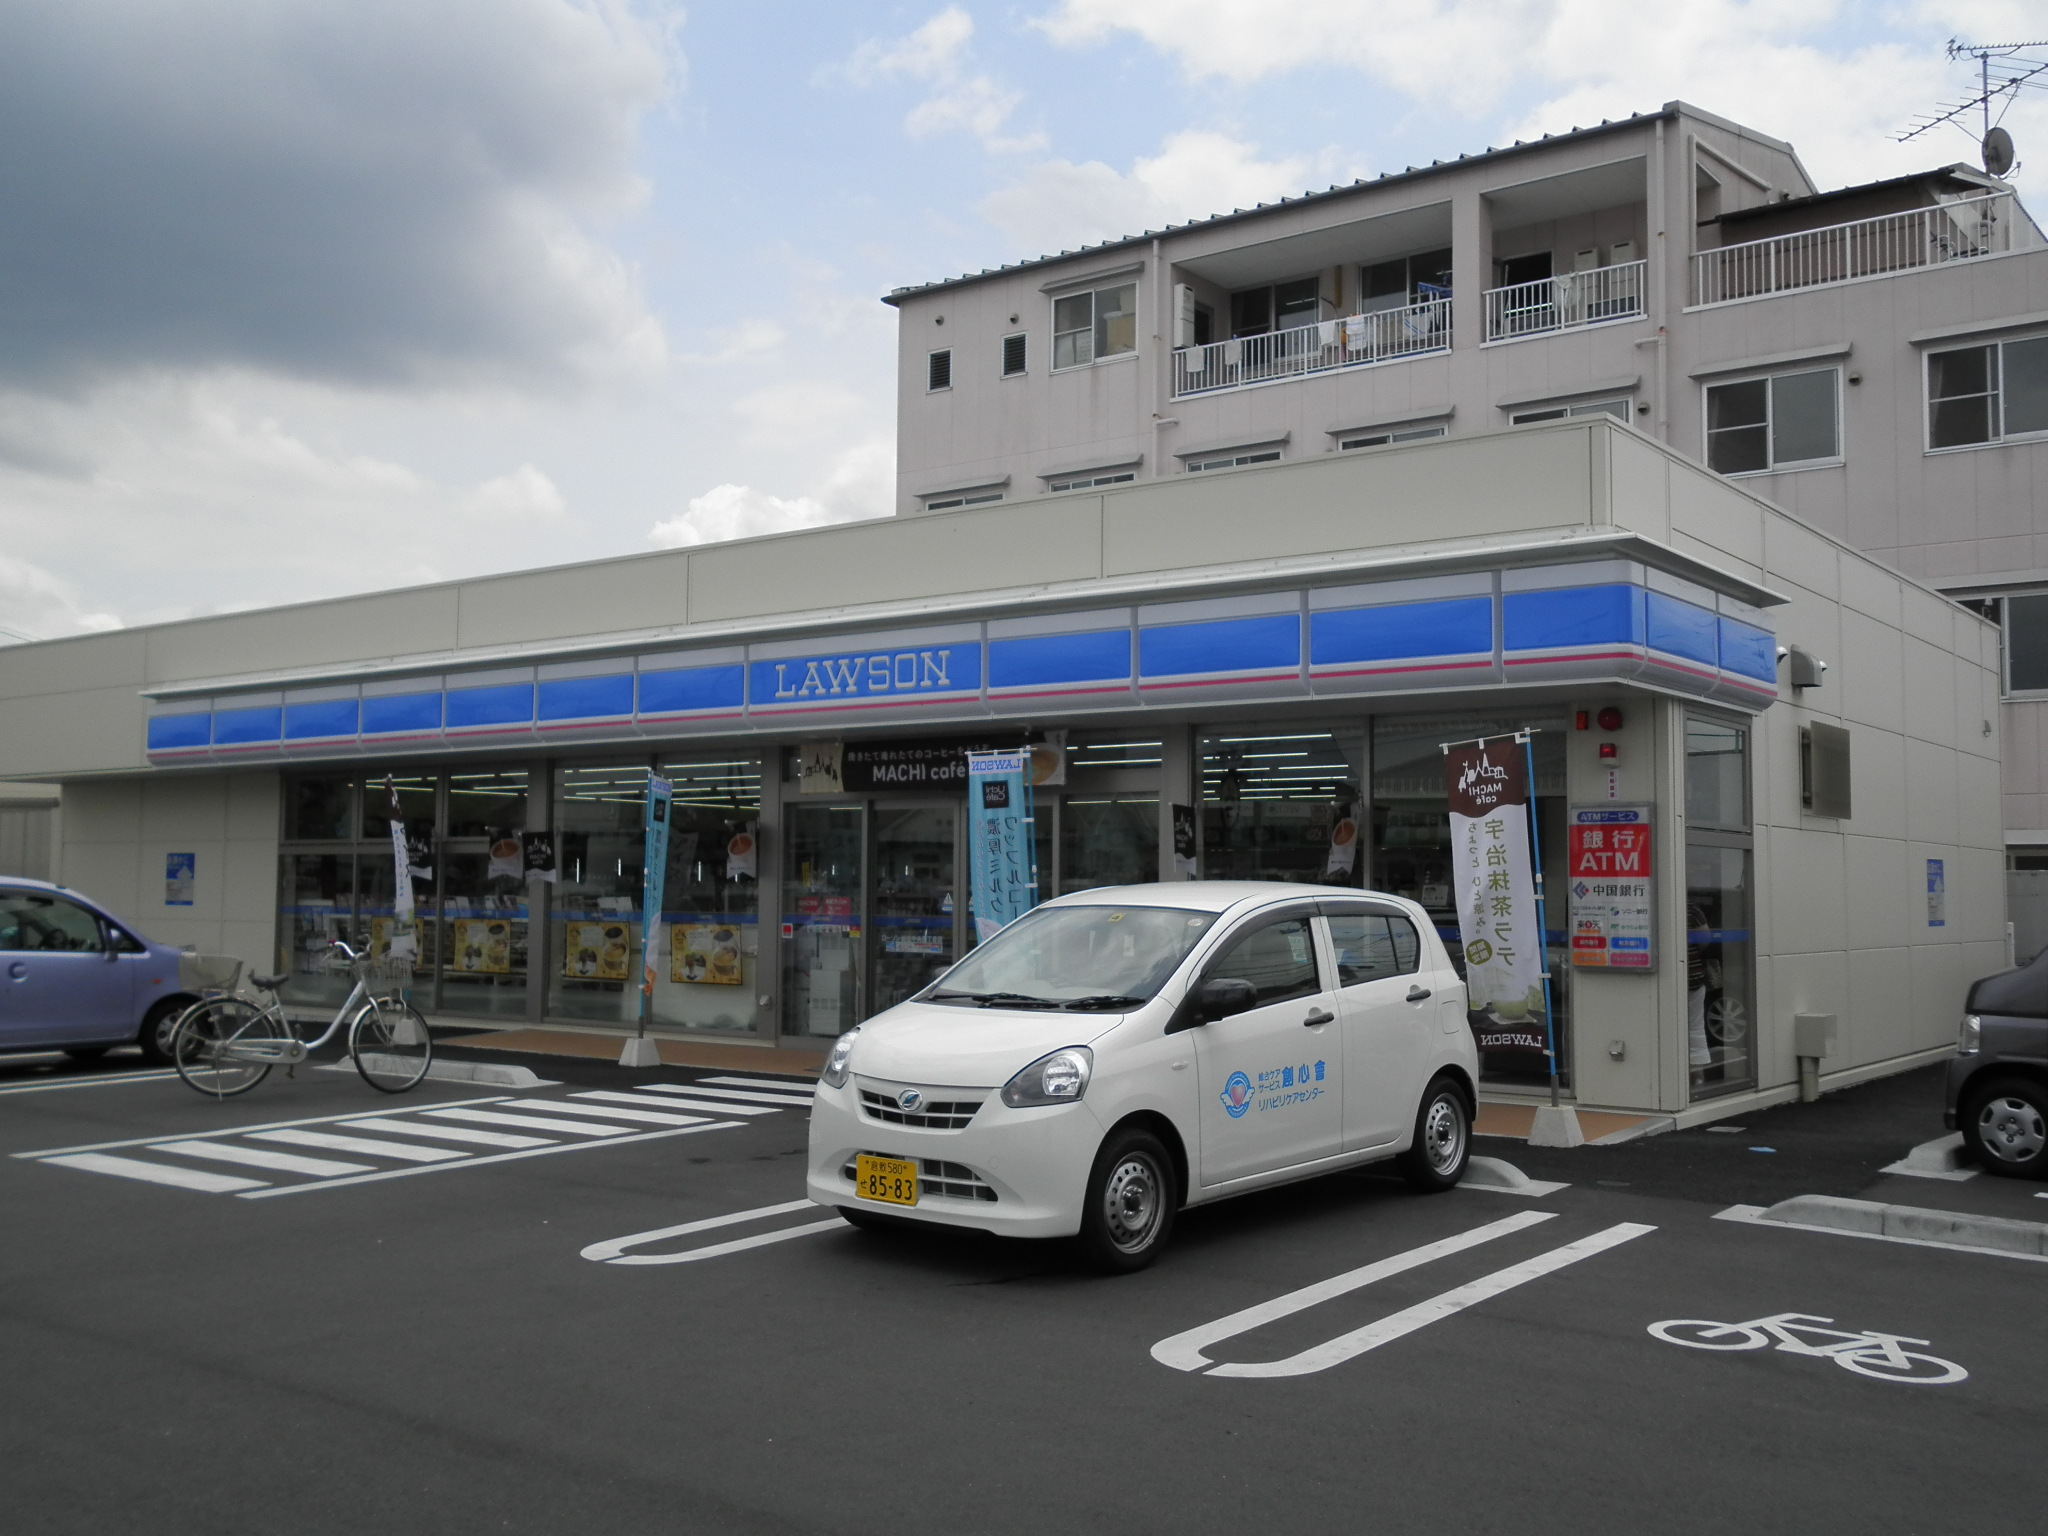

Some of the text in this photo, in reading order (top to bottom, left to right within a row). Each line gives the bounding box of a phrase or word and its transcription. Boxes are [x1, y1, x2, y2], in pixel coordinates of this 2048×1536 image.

[775, 650, 950, 697] LAWSON
[873, 761, 966, 782] MACHI café
[1580, 811, 1636, 821] ATMサービス
[1582, 830, 1635, 849] 銀行
[1579, 852, 1639, 871] ATM
[1593, 884, 1646, 897] 中国銀行
[1282, 1060, 1325, 1088] 創心會
[1259, 1080, 1280, 1093] サービス
[1259, 1087, 1325, 1111] リハビリケアセンター
[869, 1174, 913, 1200] 85-83
